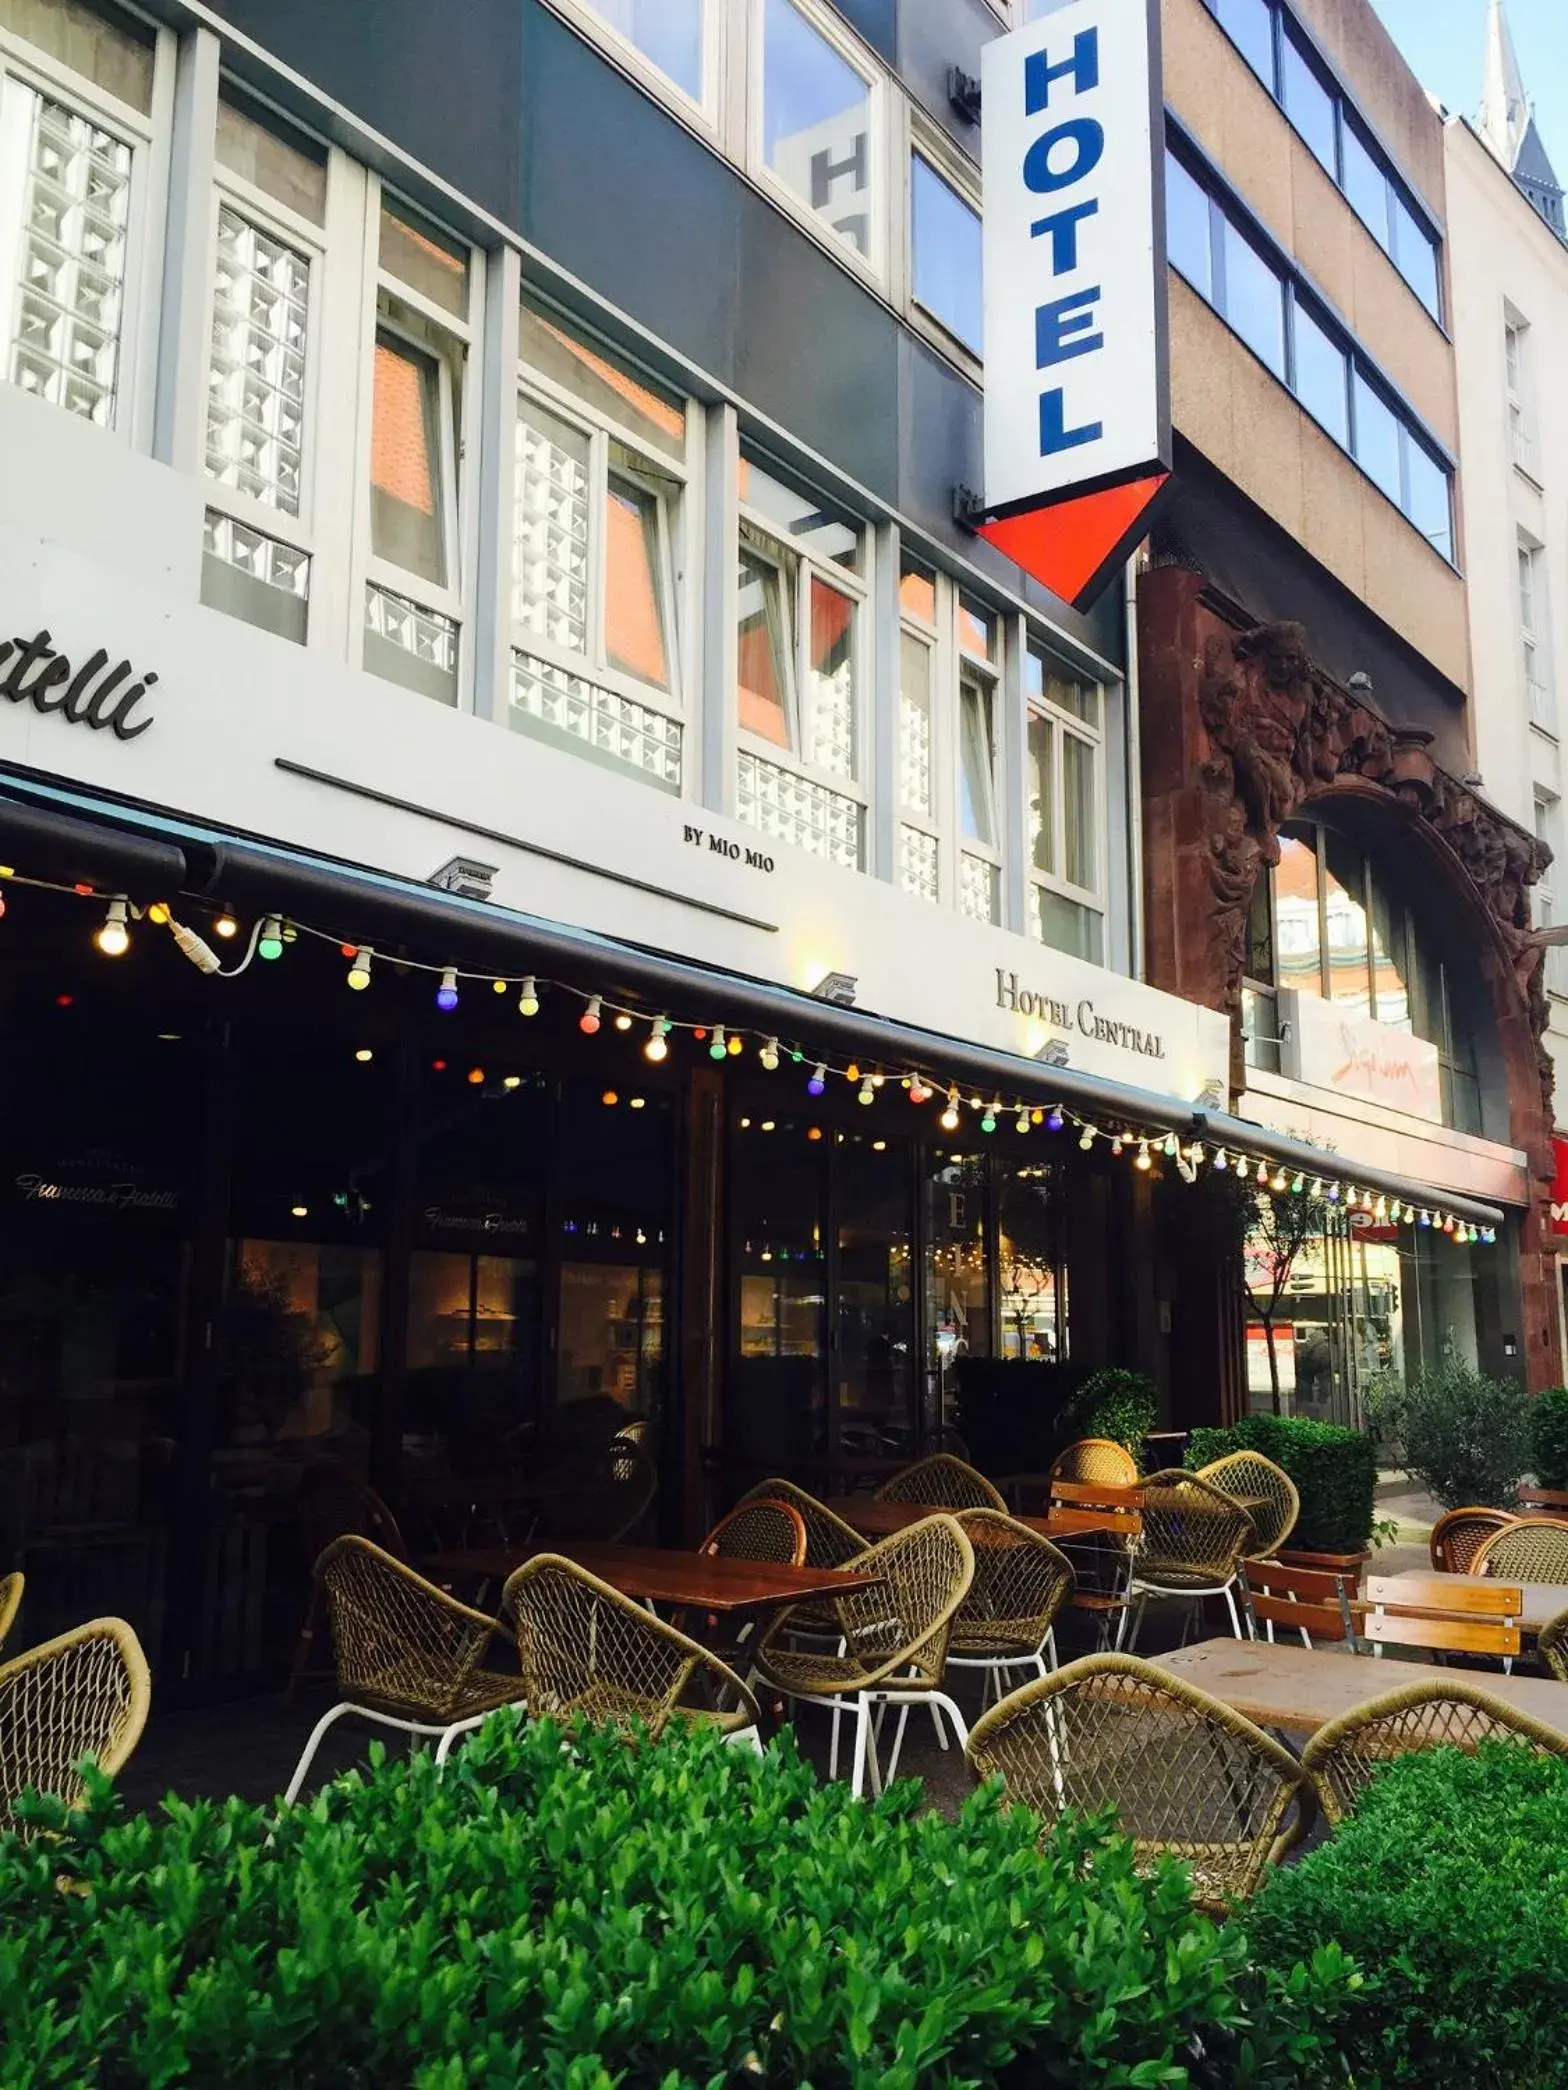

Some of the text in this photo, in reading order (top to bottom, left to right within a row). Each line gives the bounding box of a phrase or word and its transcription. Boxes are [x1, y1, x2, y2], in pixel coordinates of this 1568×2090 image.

[1023, 25, 1104, 457] HOTEL
[0, 630, 158, 740] telli
[683, 824, 775, 873] BY MIO MIO
